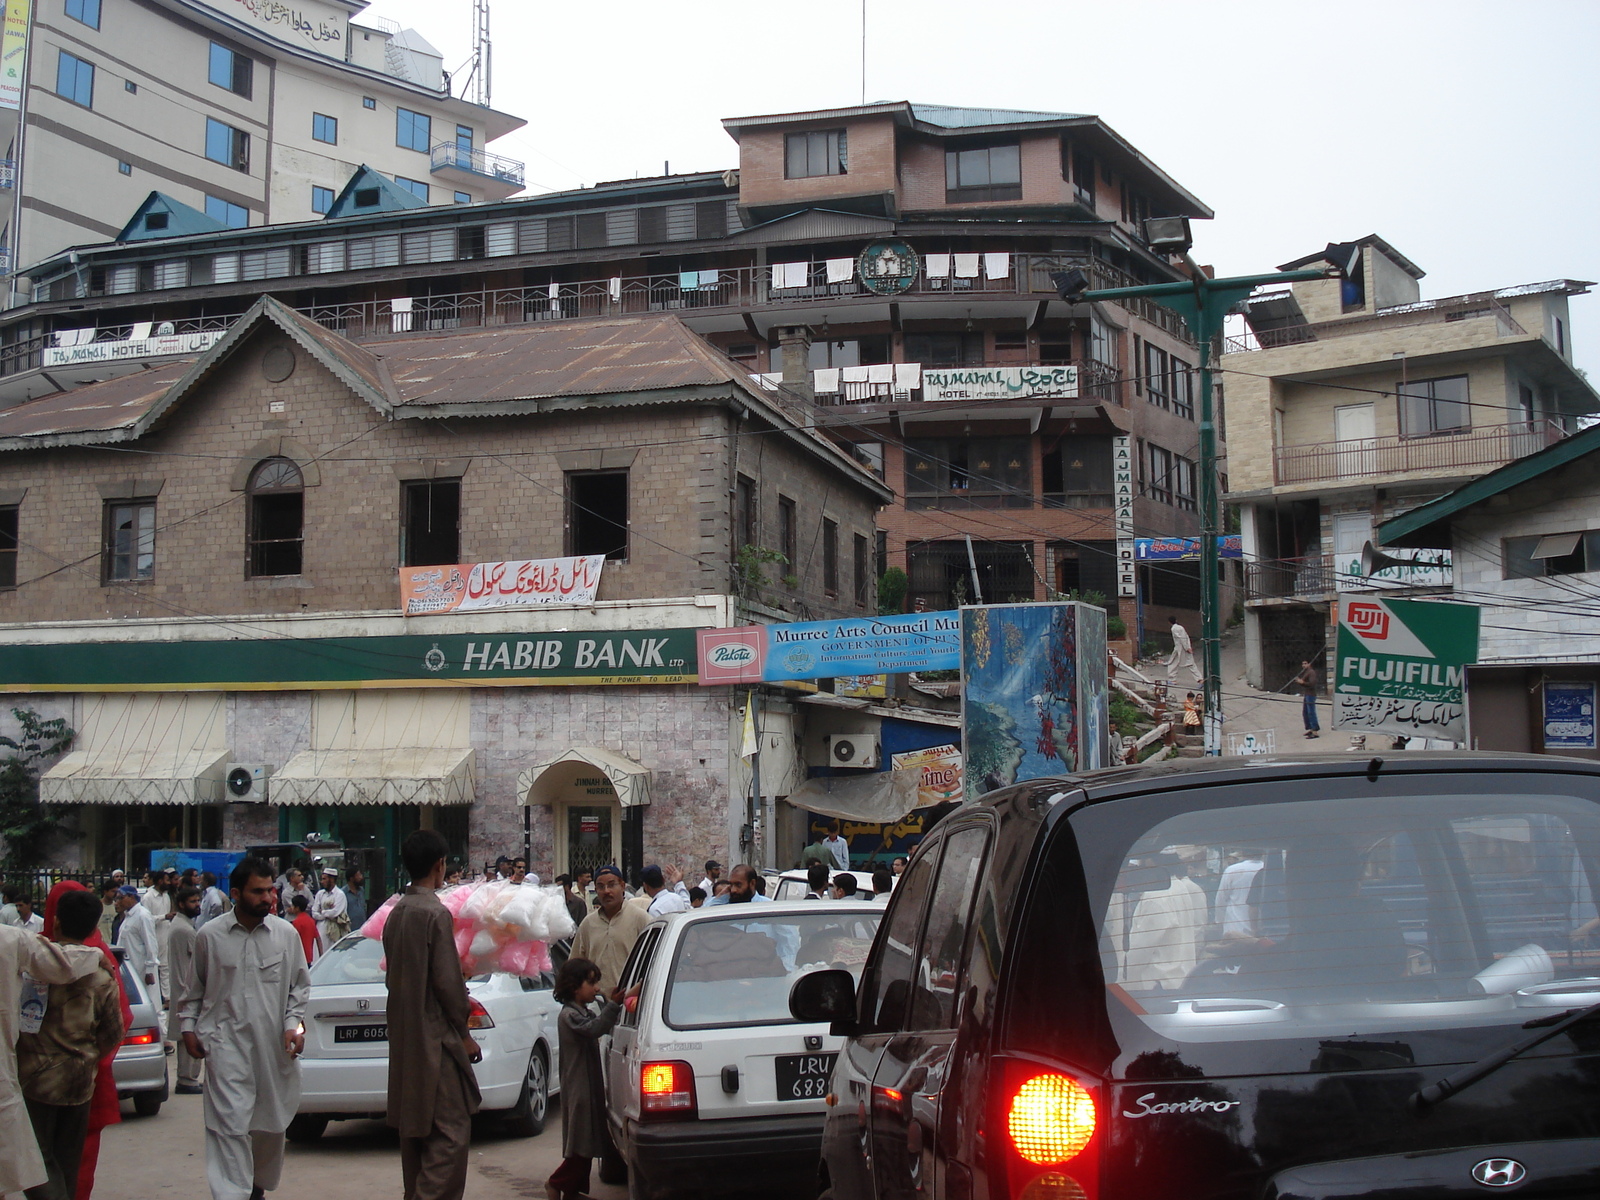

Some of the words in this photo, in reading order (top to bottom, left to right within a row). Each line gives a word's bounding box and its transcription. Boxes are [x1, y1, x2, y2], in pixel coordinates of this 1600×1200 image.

[7, 16, 27, 26] HOTEL
[5, 29, 26, 39] JAWA
[7, 68, 17, 78] &
[111, 343, 152, 357] HOTEL
[939, 390, 971, 398] HOTEL
[1347, 601, 1390, 640] FUJI
[775, 628, 829, 643] Murree
[833, 625, 867, 639] Arts
[871, 619, 929, 636] Council
[821, 637, 911, 652] GOVERNMENT
[914, 635, 931, 645] OF
[462, 639, 563, 671] HABIB
[574, 637, 670, 669] BANK
[668, 658, 685, 667] LTD
[820, 653, 872, 662] Information
[873, 649, 908, 658] Culture
[910, 647, 926, 656] and
[929, 645, 956, 655] Youth
[878, 659, 928, 669] Department
[1342, 656, 1464, 688] FUJIFILM
[574, 778, 600, 787] JINNAH
[586, 787, 614, 795] MURREE
[339, 1028, 359, 1039] LRP
[799, 1056, 830, 1075] LRU
[1122, 1092, 1240, 1119] Santro
